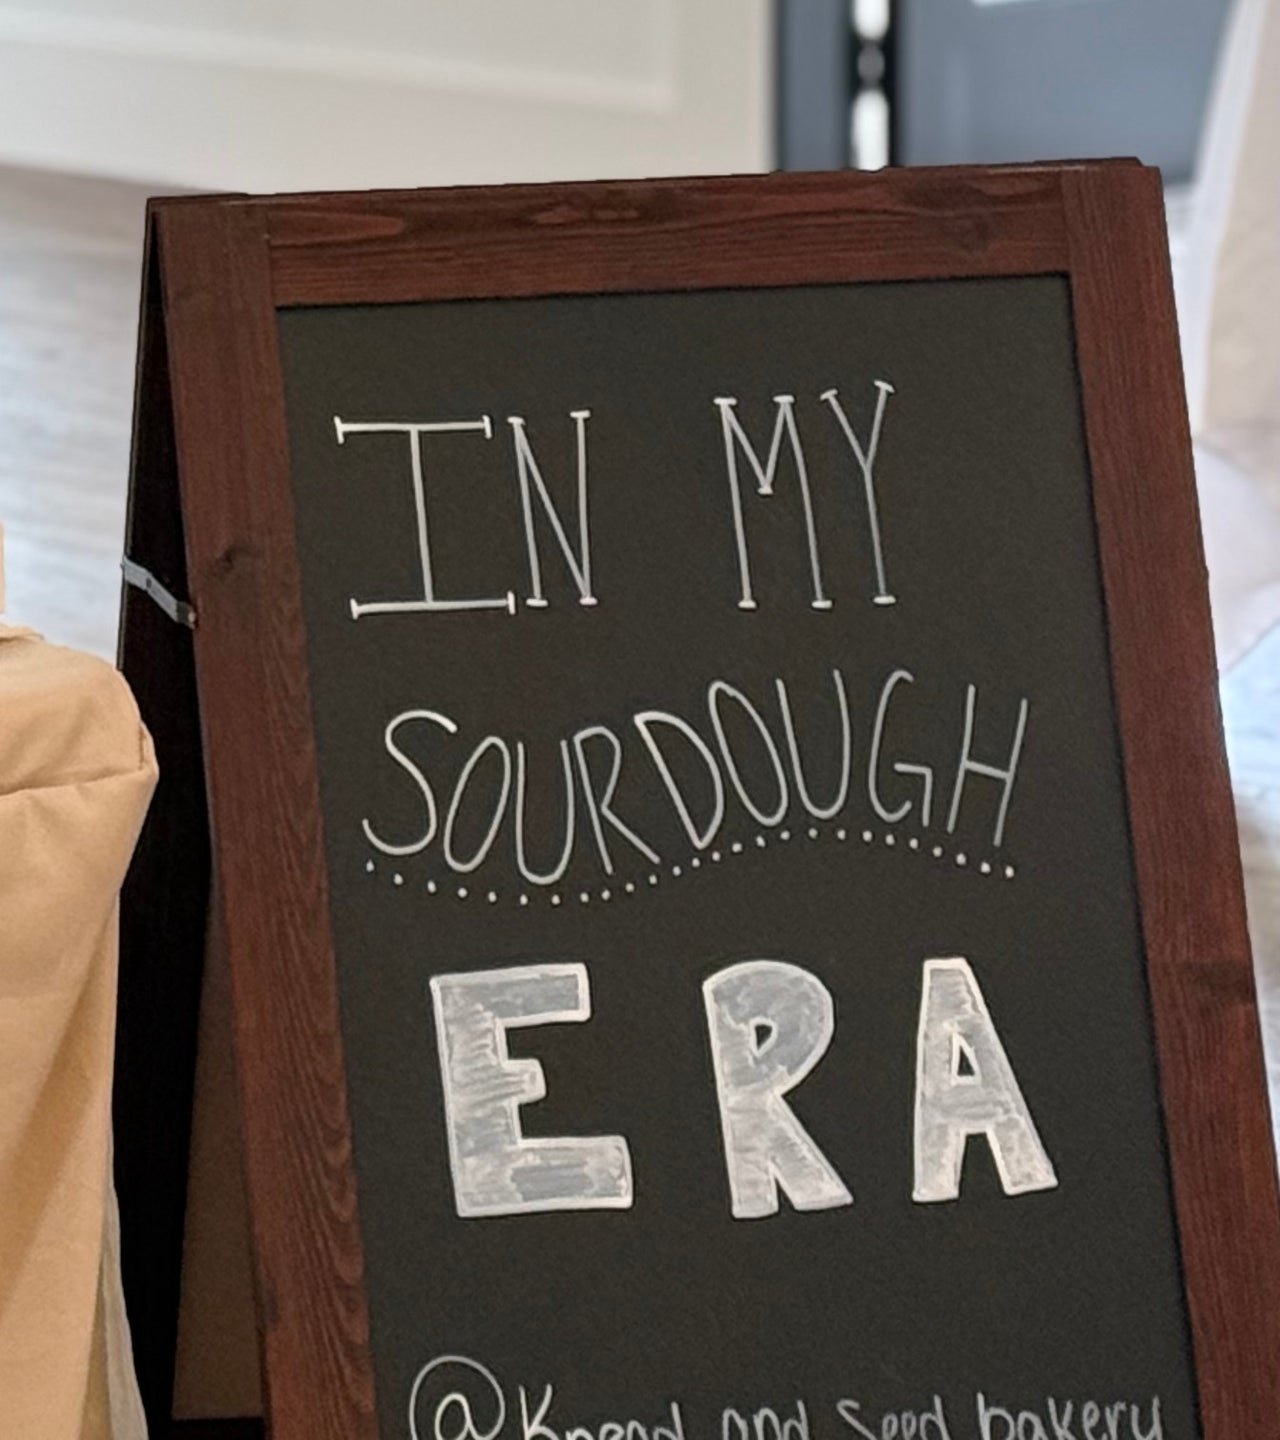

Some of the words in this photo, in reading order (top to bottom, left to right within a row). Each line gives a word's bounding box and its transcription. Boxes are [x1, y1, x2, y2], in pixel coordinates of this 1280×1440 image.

[334, 410, 597, 619] IN
[714, 380, 895, 611] MY
[362, 670, 1028, 885] SOURDOUGH
[428, 957, 1059, 1218] ERA
